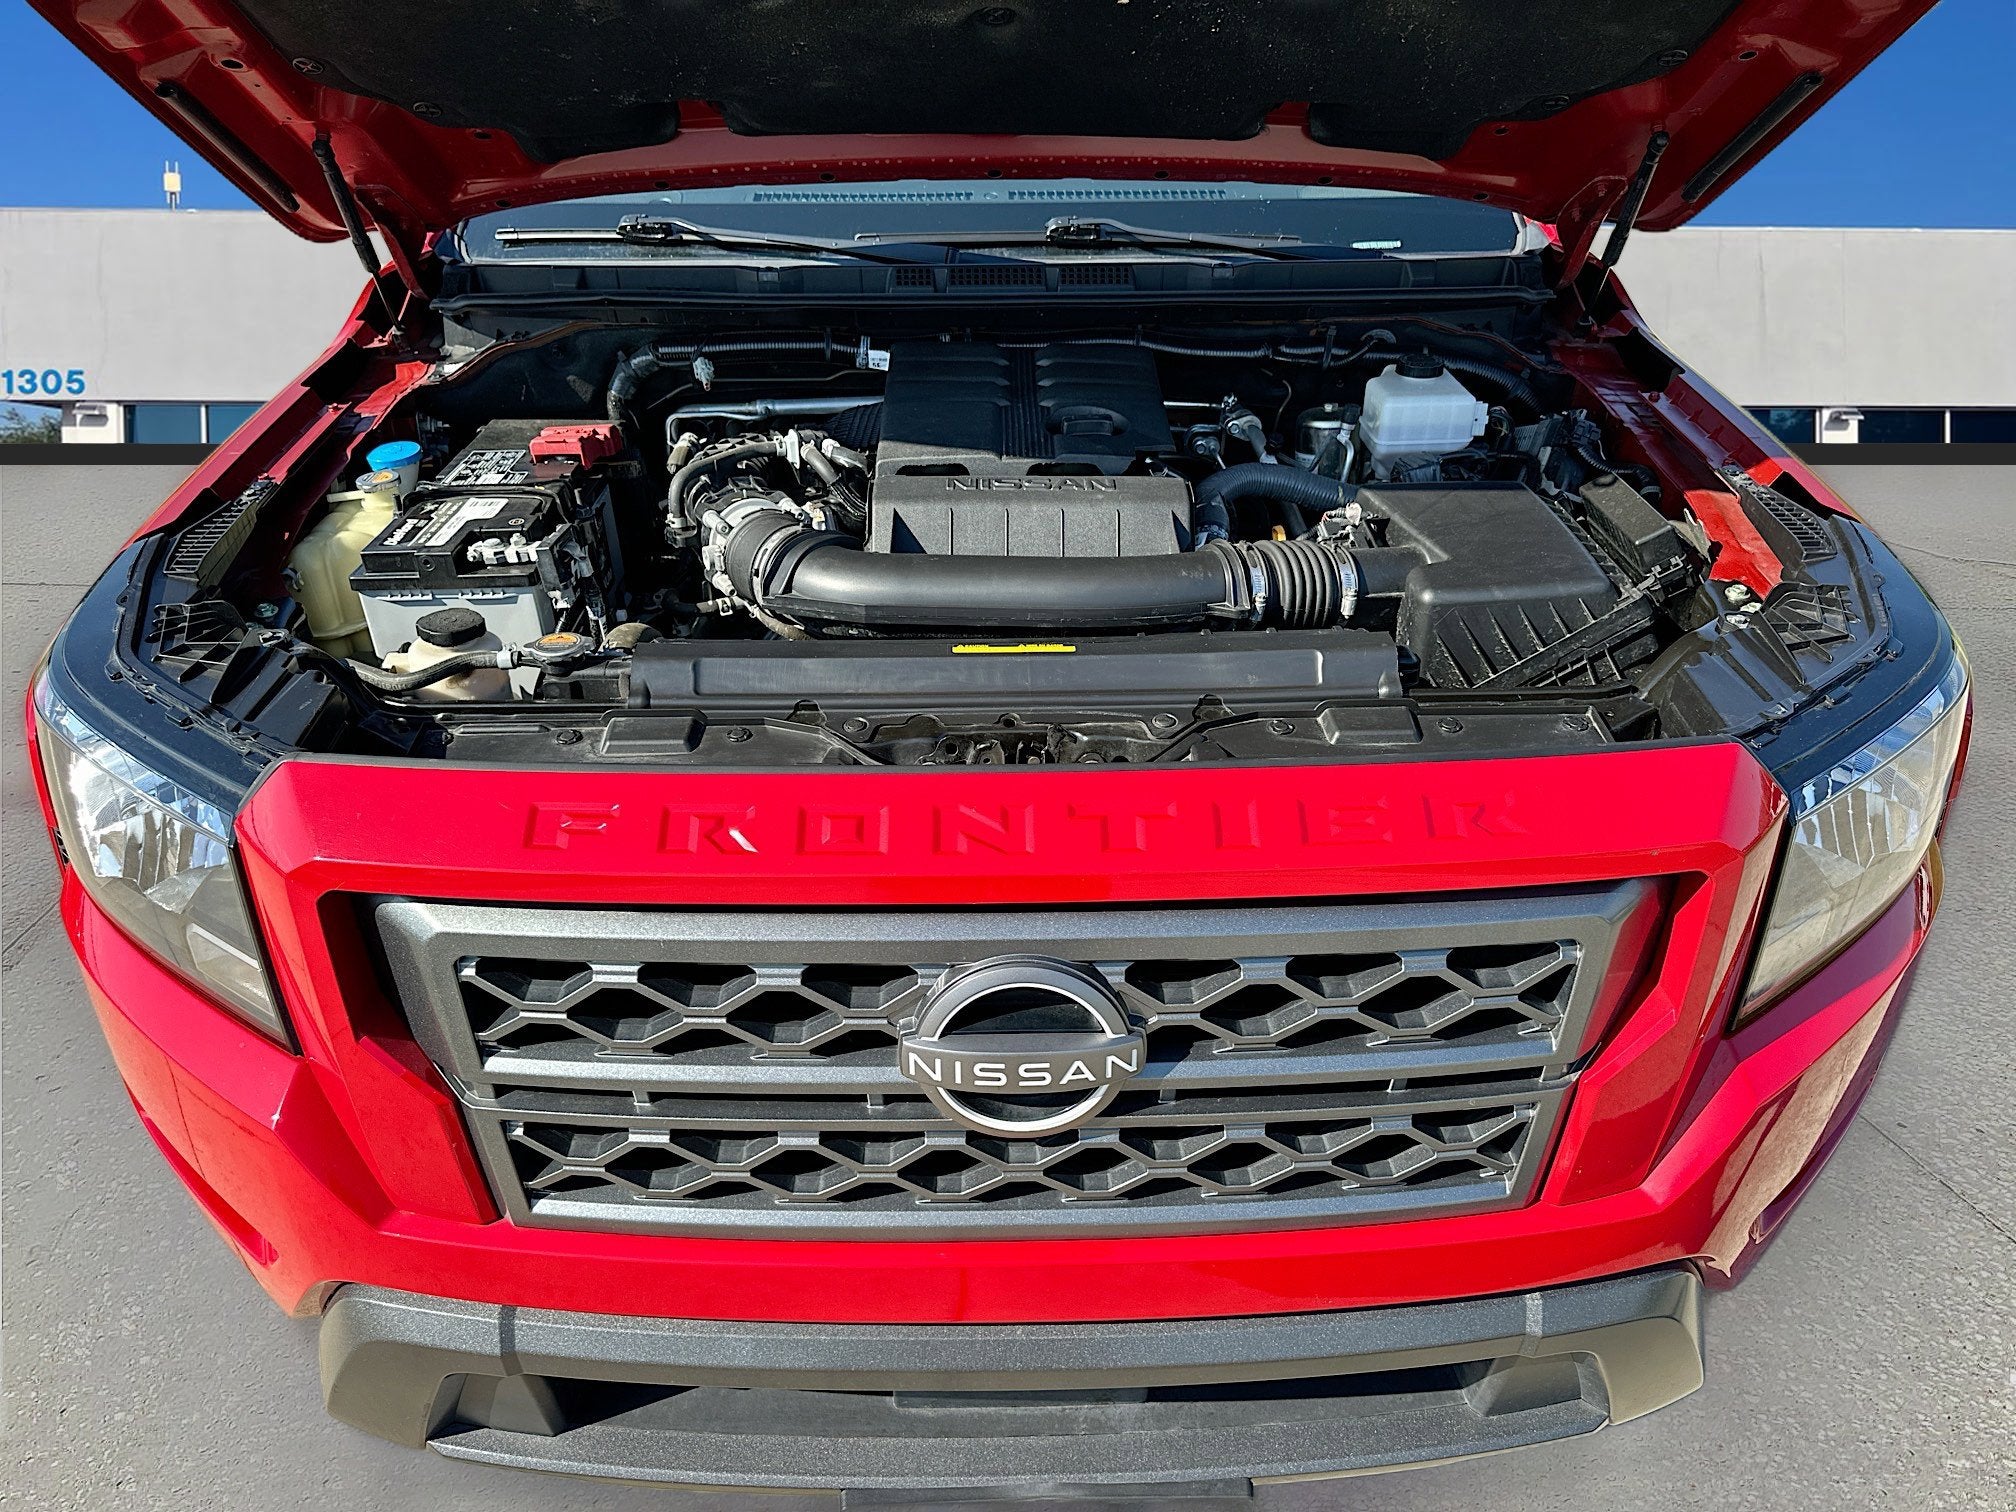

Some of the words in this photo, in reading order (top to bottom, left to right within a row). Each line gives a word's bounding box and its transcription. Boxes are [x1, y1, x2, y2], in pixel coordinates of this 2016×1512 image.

[1, 368, 85, 395] 1305
[946, 478, 1117, 491] NISSAN
[522, 791, 1530, 855] FRONTIER
[908, 1049, 1138, 1087] NISSAN
